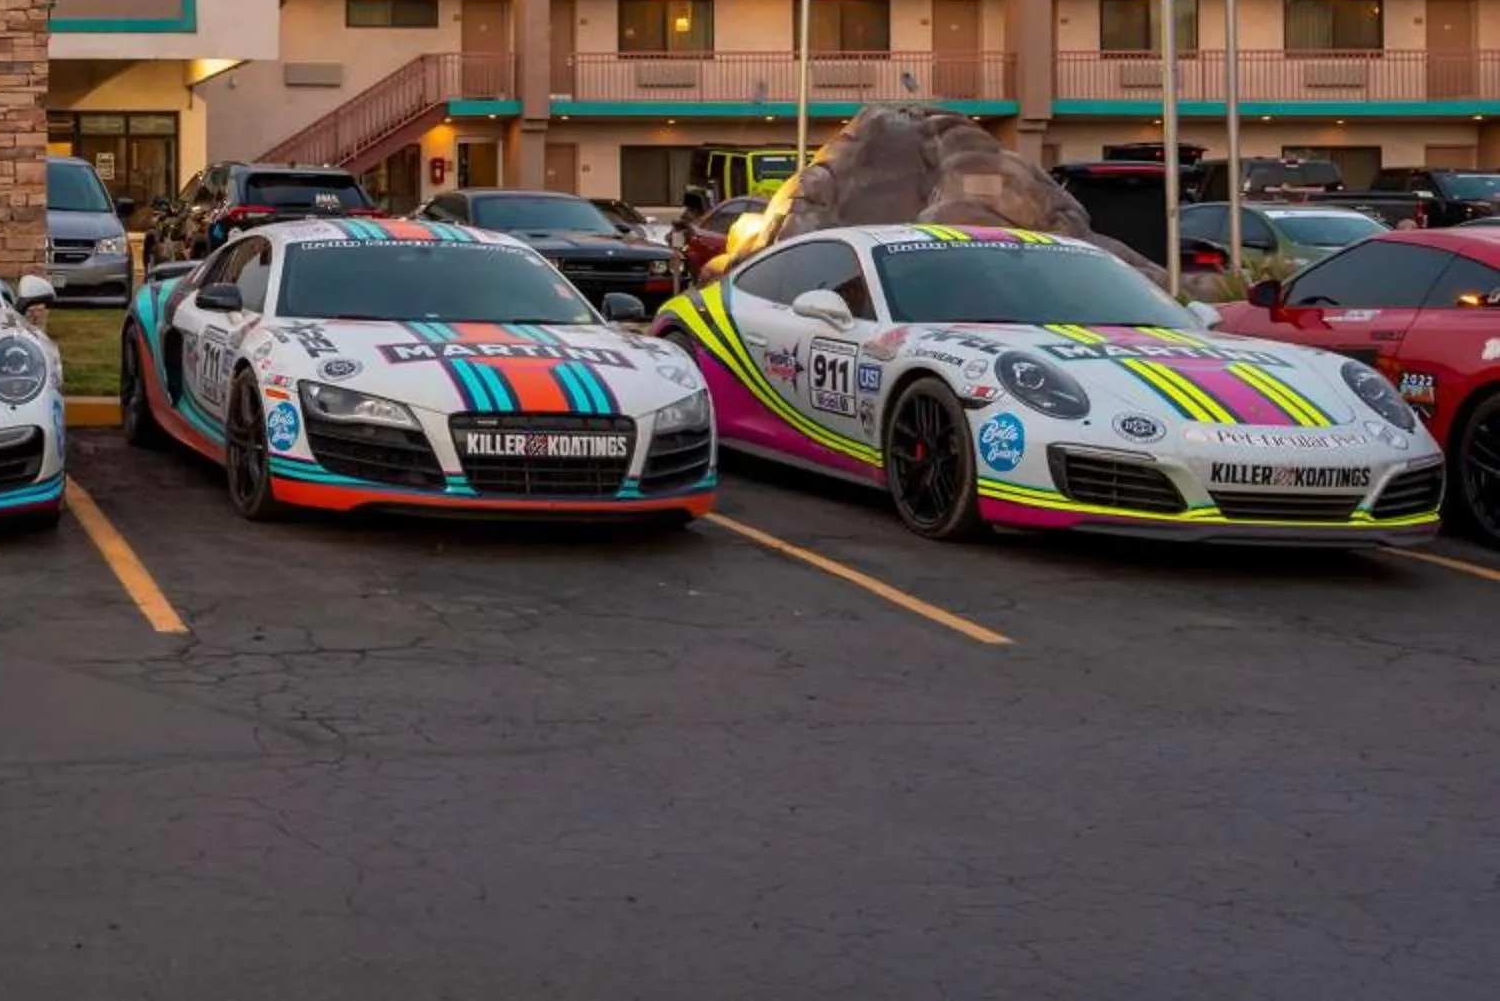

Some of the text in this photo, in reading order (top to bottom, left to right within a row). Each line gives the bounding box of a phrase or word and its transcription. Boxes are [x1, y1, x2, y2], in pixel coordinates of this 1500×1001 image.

[393, 344, 621, 364] MARTINI
[1052, 345, 1282, 366] MARTINI
[813, 354, 849, 393] 911
[1402, 371, 1434, 387] 2022
[467, 432, 627, 457] KILLER KOATINGS
[1210, 462, 1372, 488] KILLER KOATINGS
